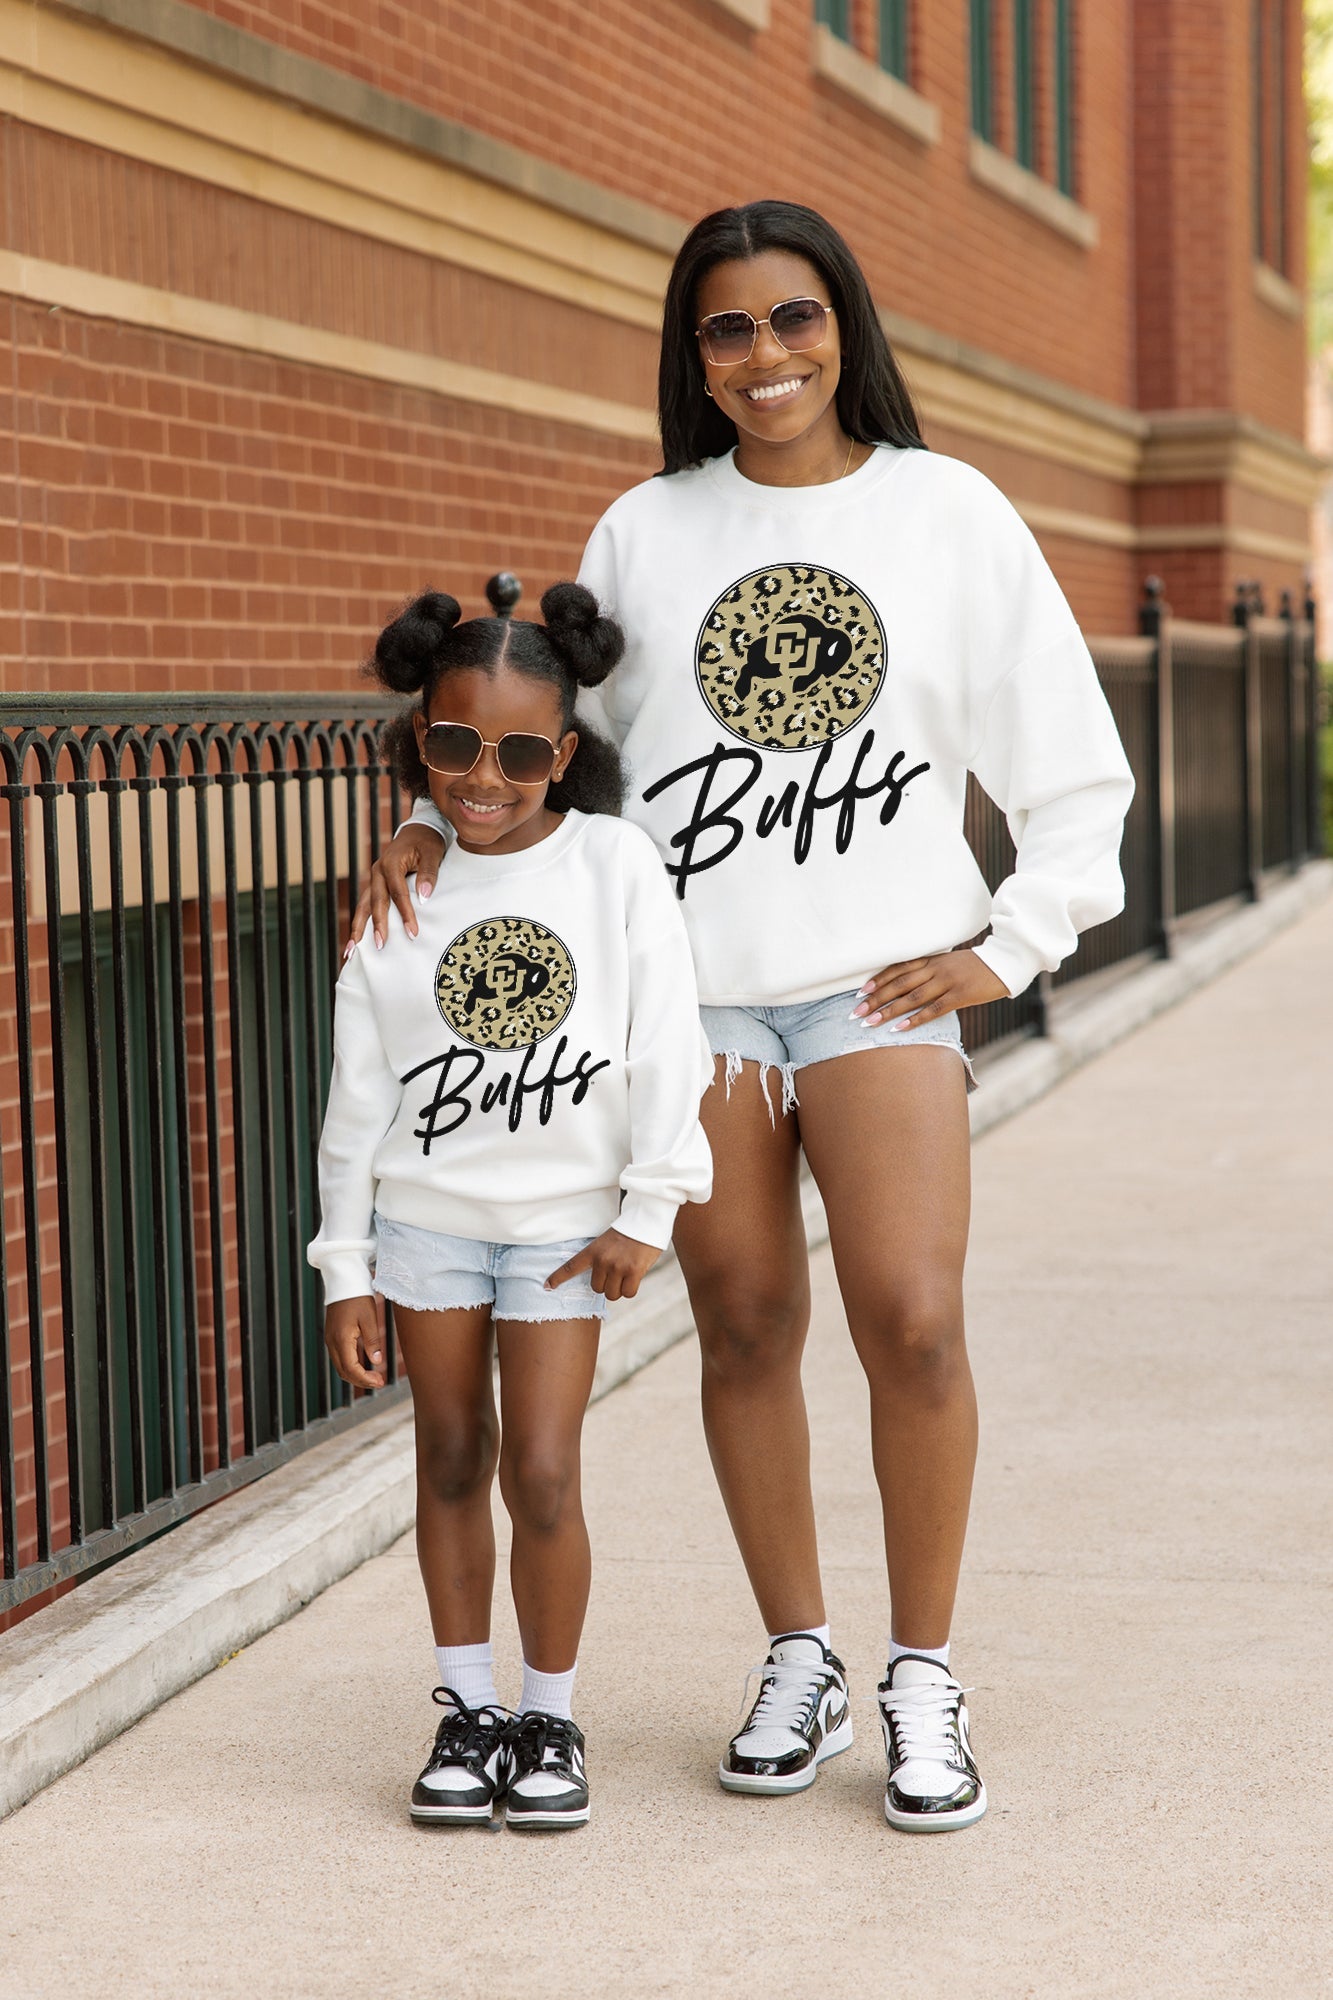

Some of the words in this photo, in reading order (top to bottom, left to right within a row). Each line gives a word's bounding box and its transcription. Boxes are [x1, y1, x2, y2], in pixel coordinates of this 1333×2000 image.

[765, 622, 822, 676] CU
[642, 729, 931, 901] Buffs
[486, 959, 527, 998] CU
[399, 1035, 611, 1156] Buffs
